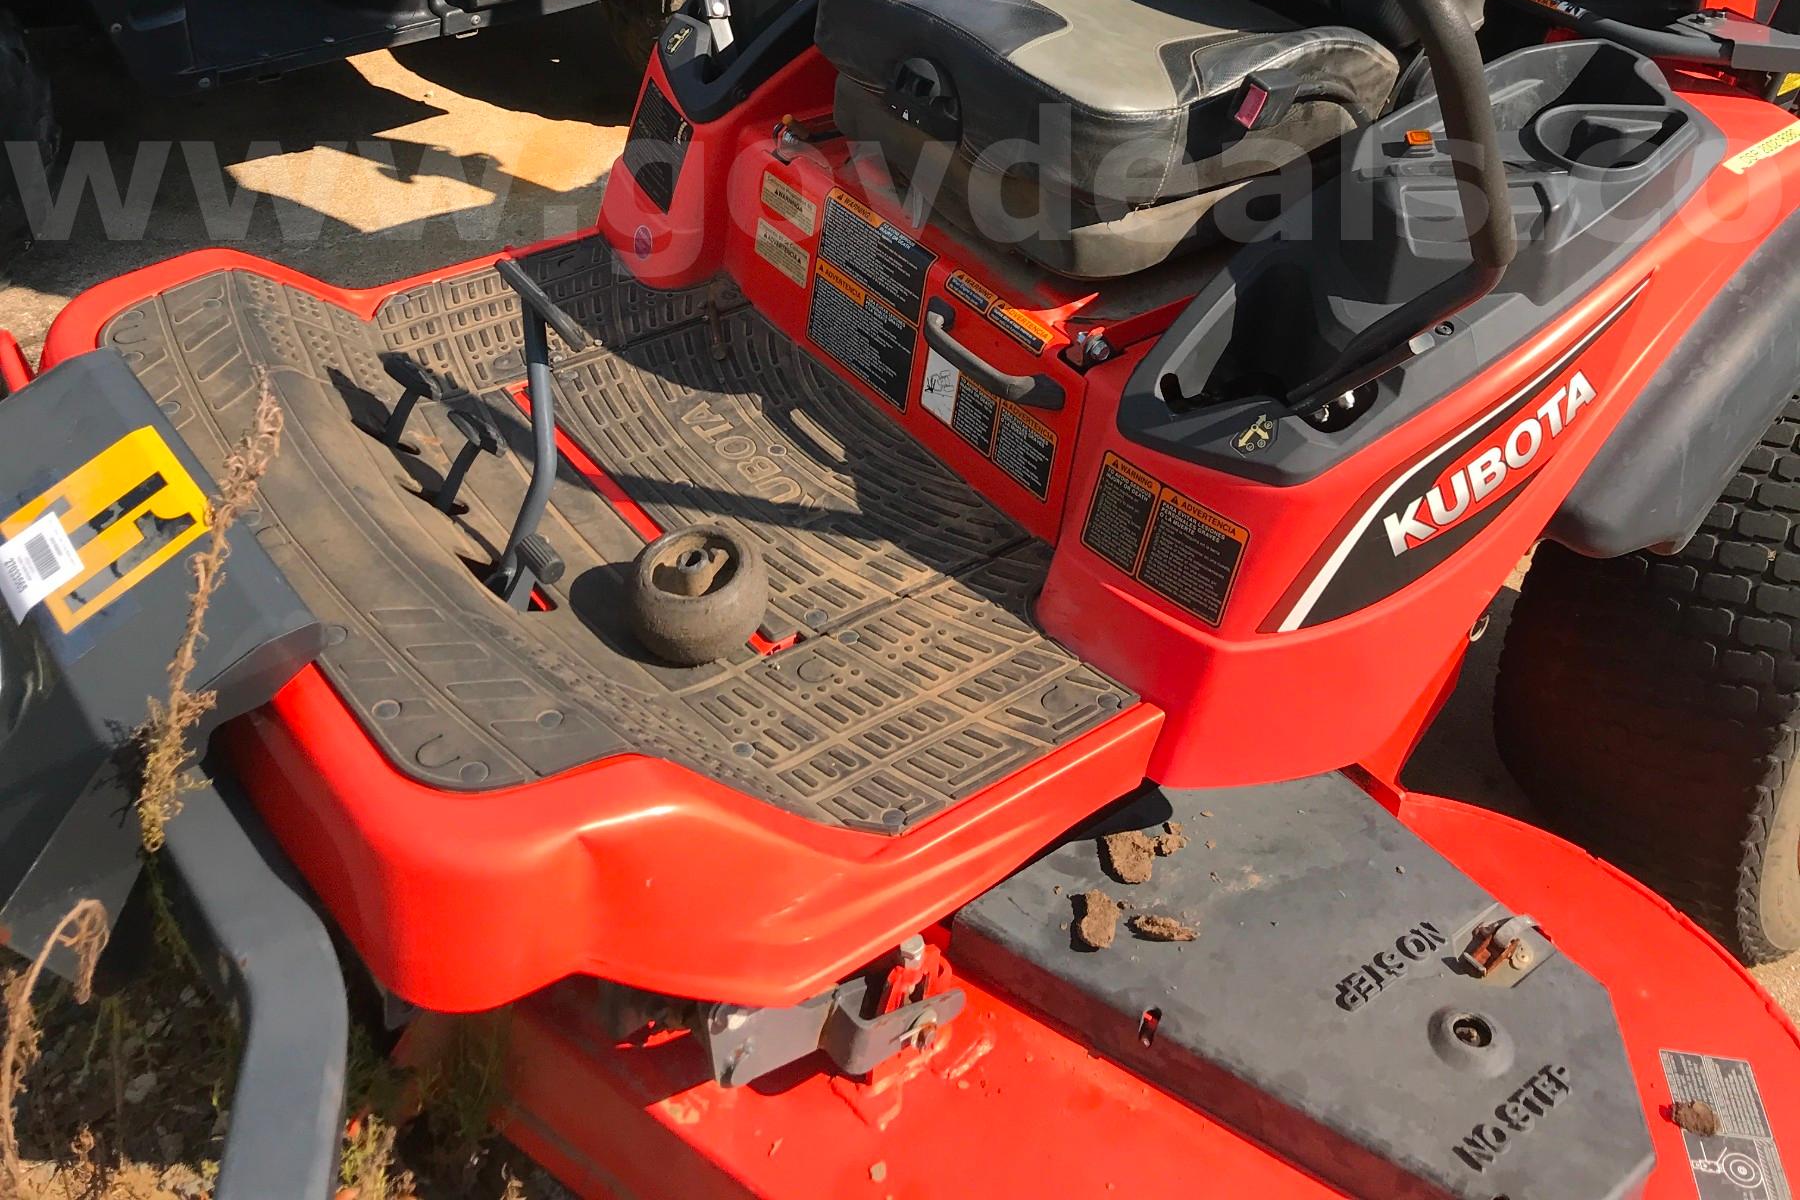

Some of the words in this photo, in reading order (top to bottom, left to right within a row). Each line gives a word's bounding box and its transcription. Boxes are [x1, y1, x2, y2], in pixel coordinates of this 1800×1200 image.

[1121, 463, 1153, 489] WARNING
[1383, 370, 1598, 557] KUBOTA
[1181, 501, 1236, 537] ADVERTENCIA
[1395, 921, 1448, 962] NO
[1335, 950, 1407, 1013] STEP
[1452, 1122, 1512, 1175] NO
[1494, 1063, 1574, 1133] STEP
